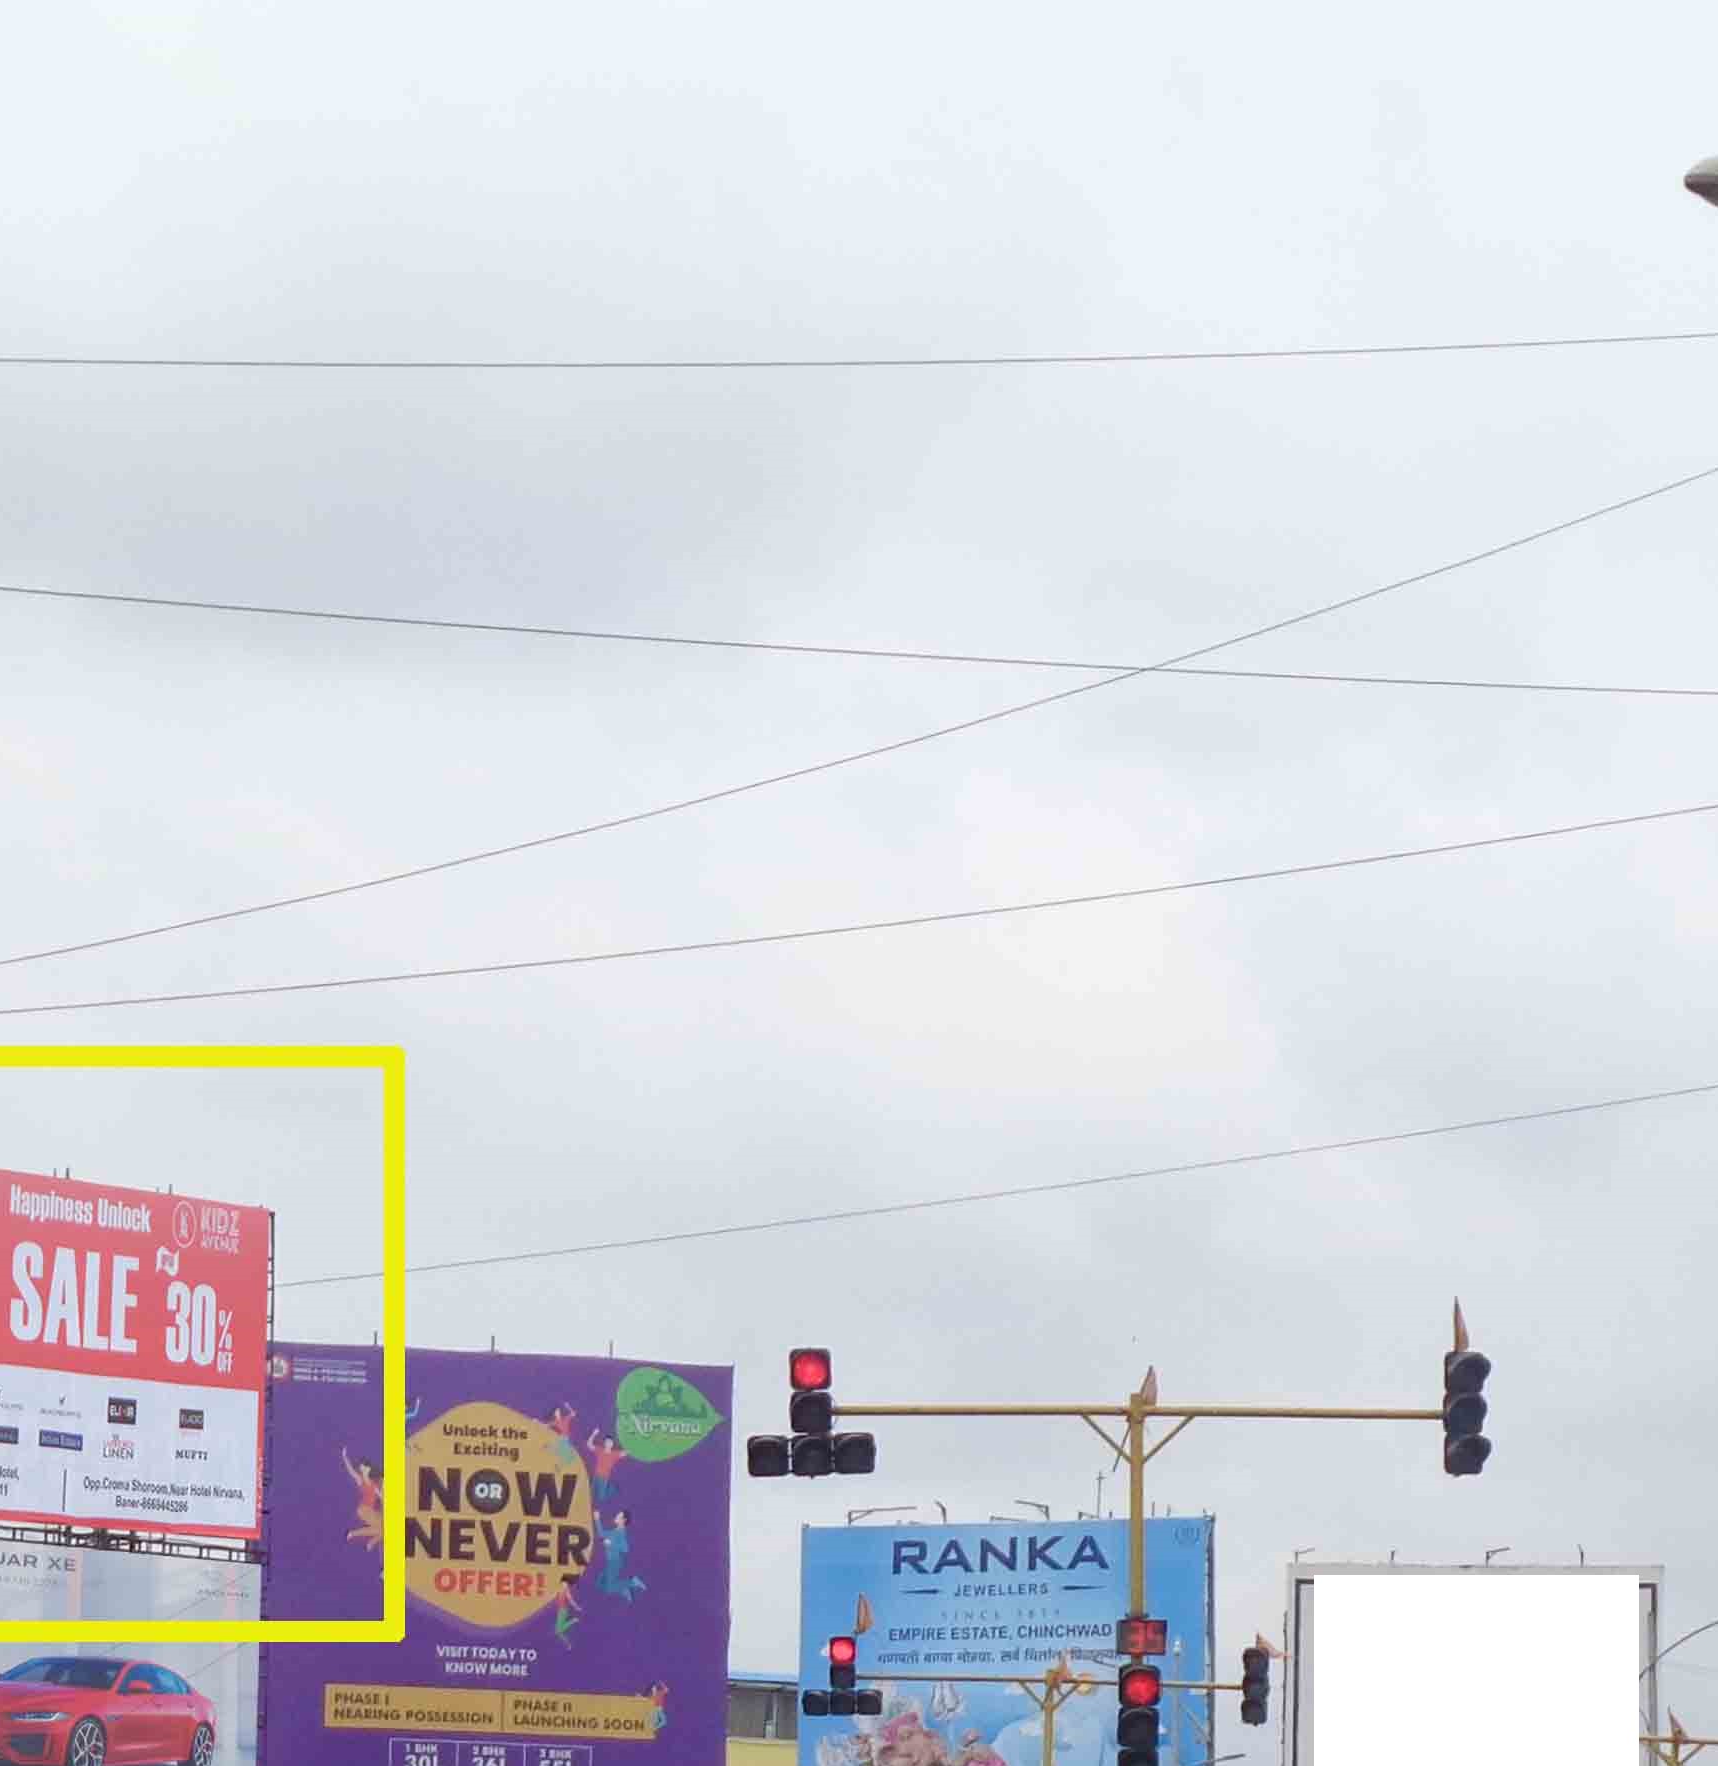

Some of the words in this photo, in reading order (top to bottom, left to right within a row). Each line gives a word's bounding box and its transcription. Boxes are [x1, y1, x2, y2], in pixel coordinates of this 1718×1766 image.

[10, 1184, 93, 1225] Happiness
[97, 1198, 151, 1232] Unlock
[201, 1206, 241, 1236] KIDZ
[10, 1241, 140, 1353] SALE
[442, 1424, 499, 1440] Unlock
[501, 1426, 529, 1440] the
[453, 1442, 521, 1463] Exciting
[474, 1482, 503, 1500] OR
[405, 1516, 591, 1567] NEVER
[892, 1535, 1110, 1575] RANKA
[48, 1557, 77, 1572] XE
[434, 1567, 547, 1599] OFFER!
[954, 1582, 1049, 1598] JEWELLERS
[889, 1626, 947, 1642] EMPIRE
[950, 1626, 1013, 1643] ESTATE,
[1017, 1623, 1113, 1639] CHINCHWAD
[436, 1644, 471, 1659] VISIT
[472, 1647, 518, 1661] TODAY
[519, 1649, 538, 1662] TO
[445, 1661, 488, 1676] KNOW
[489, 1664, 529, 1677] MORE
[334, 1693, 381, 1706] PHASE
[514, 1700, 559, 1713] PHASE
[333, 1708, 401, 1722] NEARING
[405, 1710, 495, 1725] POSSESSION
[513, 1715, 599, 1730] LAUNCHING
[603, 1717, 645, 1732] SOON
